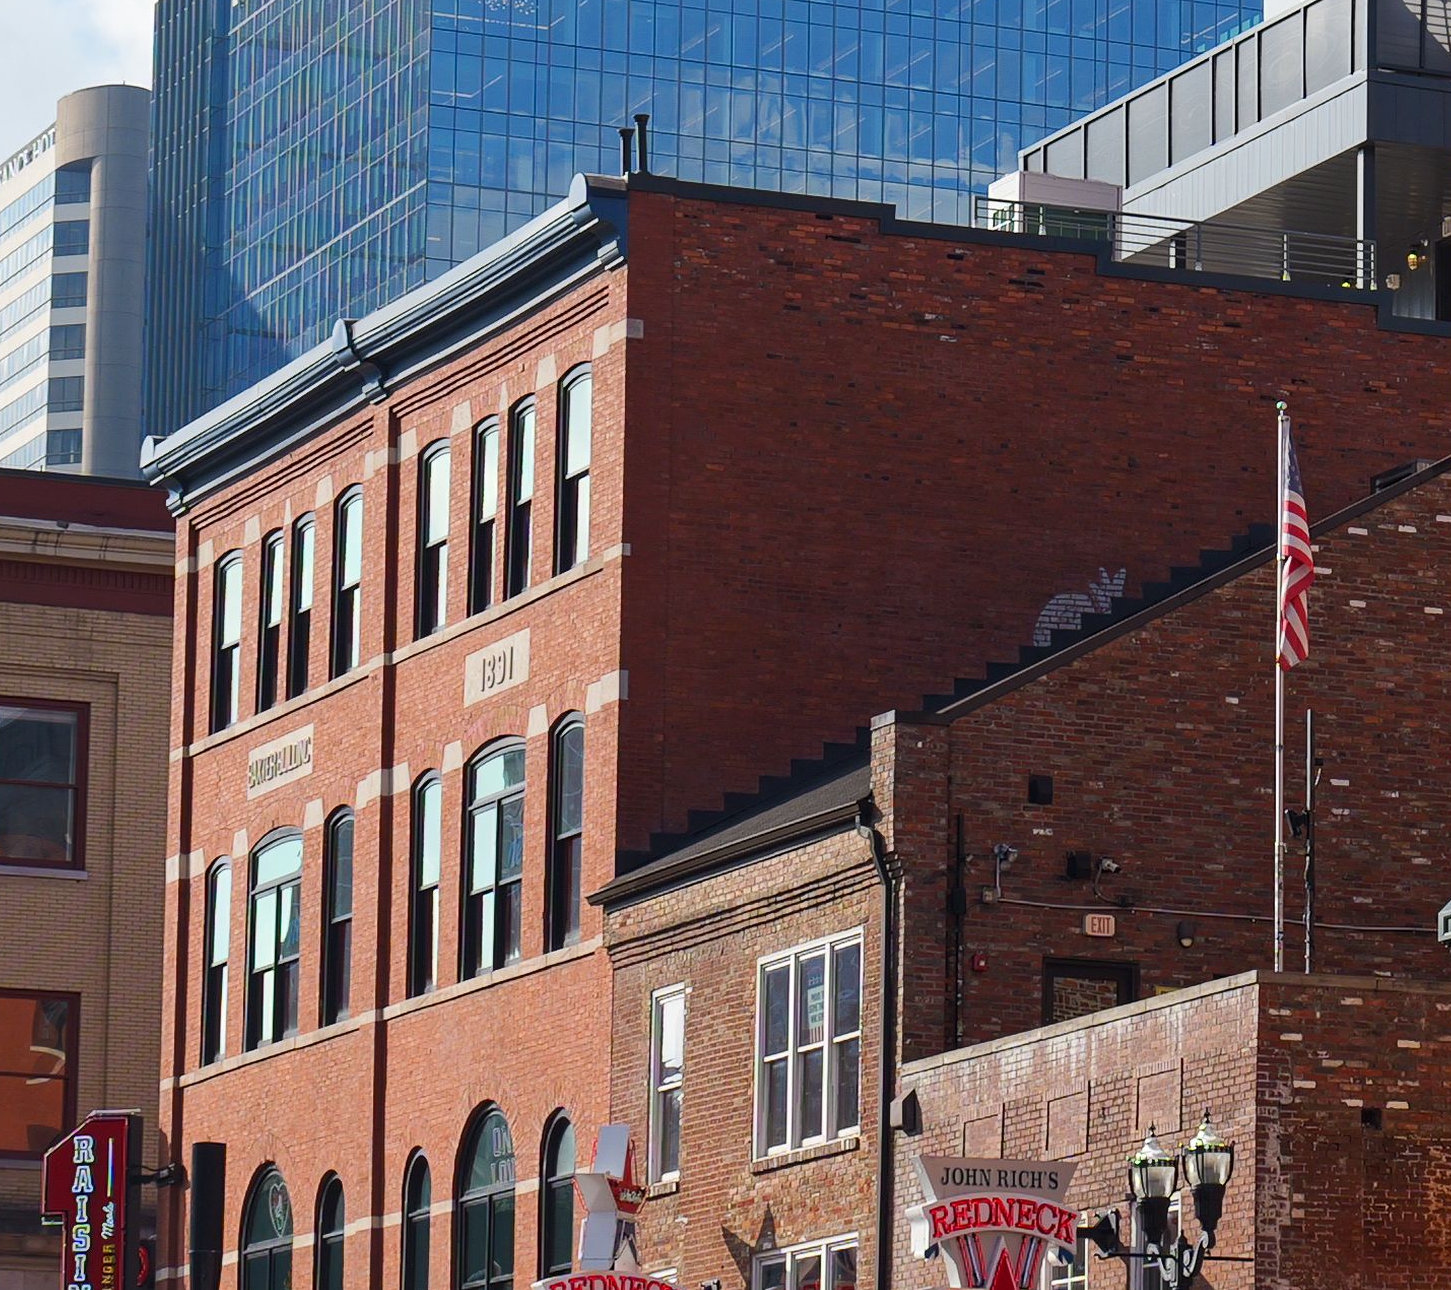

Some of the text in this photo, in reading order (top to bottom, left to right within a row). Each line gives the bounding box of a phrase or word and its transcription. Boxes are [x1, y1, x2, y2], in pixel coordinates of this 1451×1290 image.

[479, 646, 515, 693] 1891
[1090, 916, 1111, 934] EXIT
[940, 1165, 1060, 1191] JOHN RICH'S
[929, 1196, 1078, 1245] REDNECK
